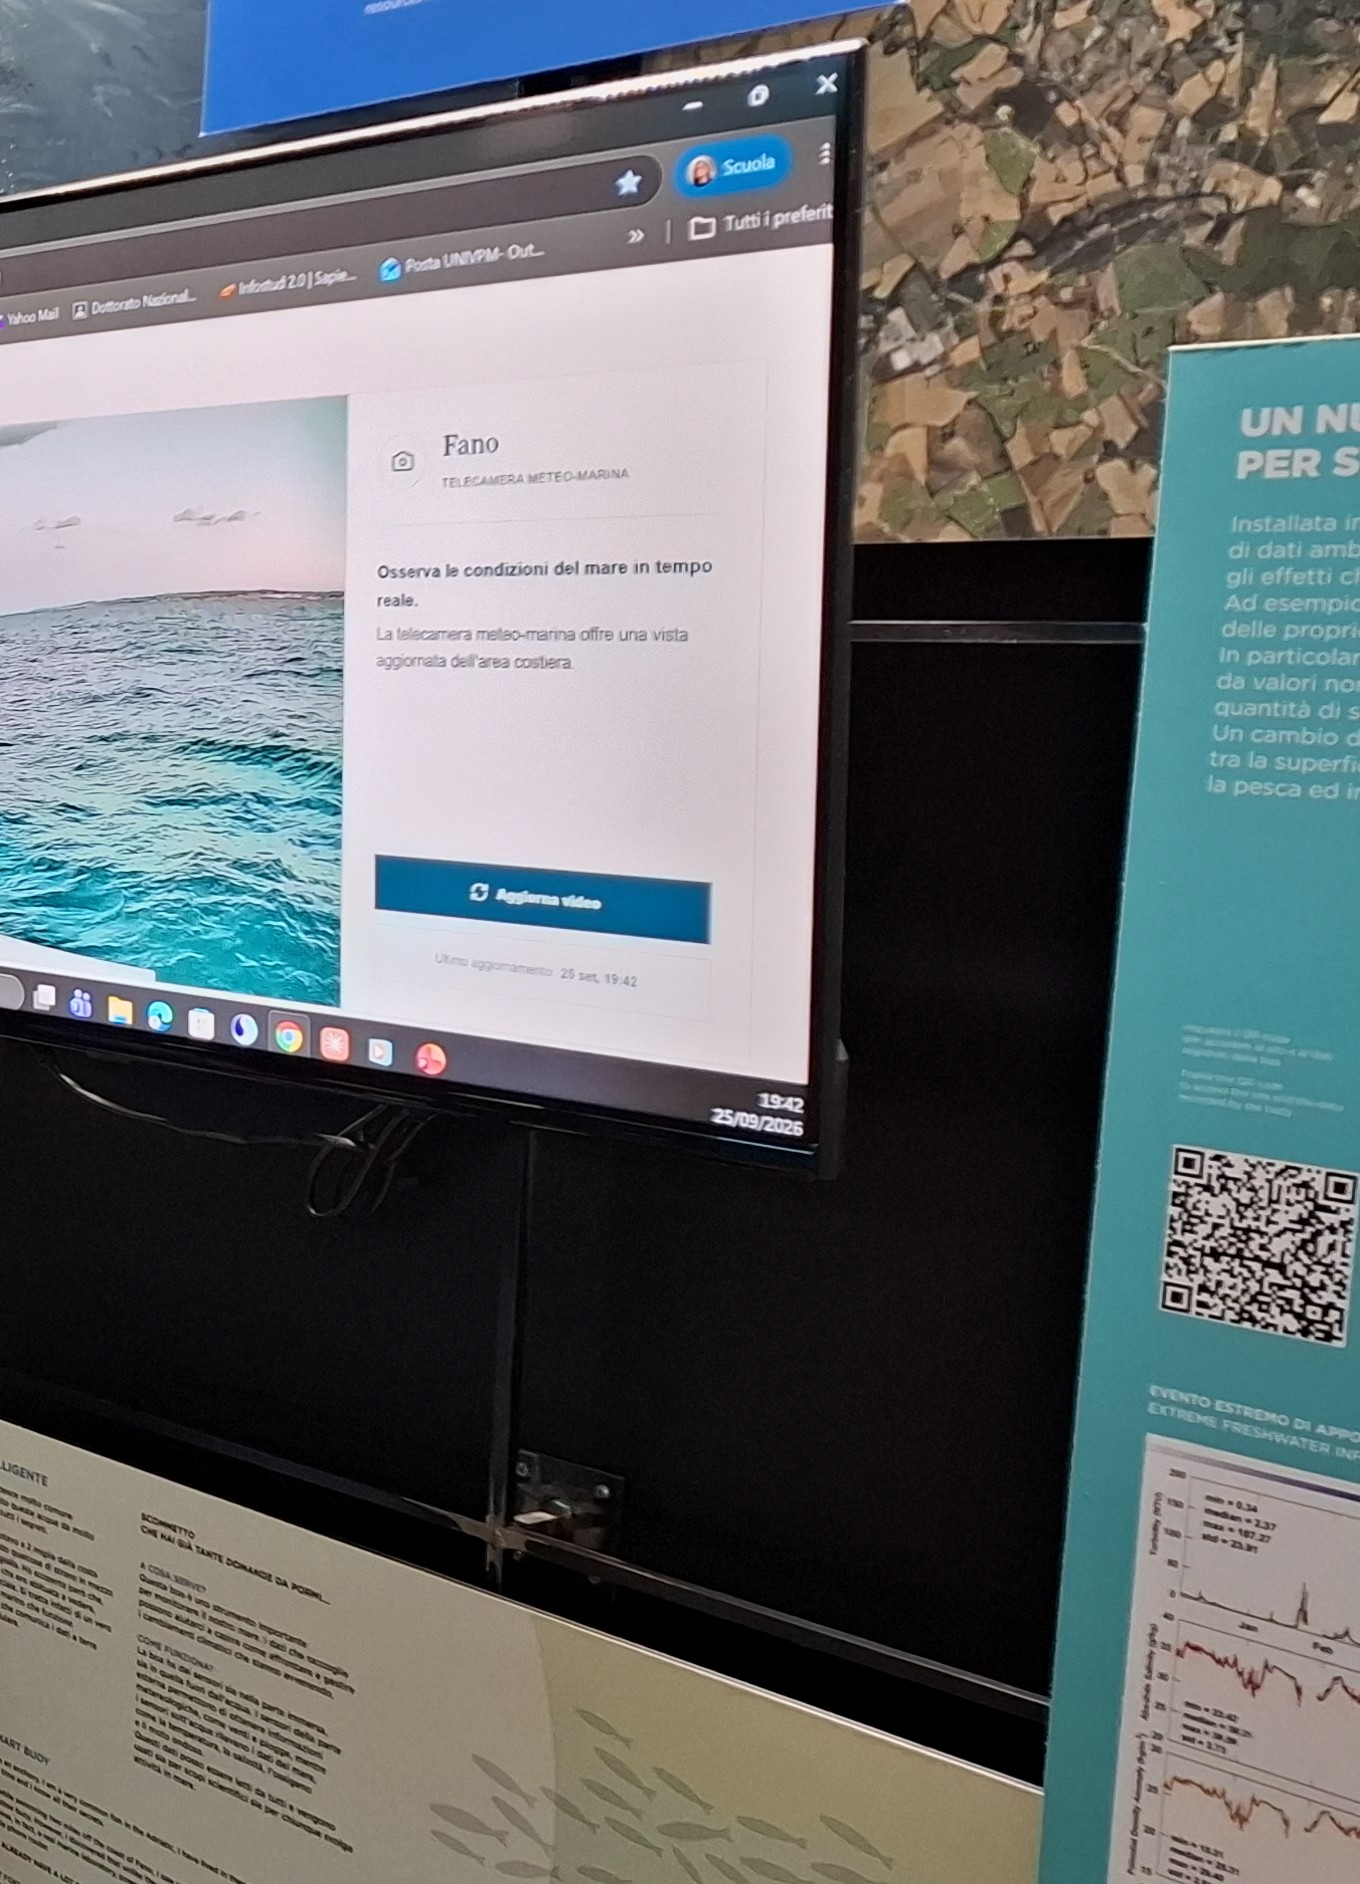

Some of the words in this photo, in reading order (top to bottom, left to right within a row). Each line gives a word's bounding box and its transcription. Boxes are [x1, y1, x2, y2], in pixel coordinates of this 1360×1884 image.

[722, 153, 776, 176] Scuola
[722, 210, 761, 233] Tutti
[405, 258, 441, 272] Posta
[7, 312, 36, 326] Yahoo
[38, 307, 59, 321] Mail
[92, 299, 141, 315] Dottorato
[1241, 406, 1303, 437] UN
[443, 434, 499, 457] Fano
[1237, 449, 1320, 479] PER
[442, 474, 523, 488] TELECAMERA
[527, 468, 628, 484] METEO-MARINA
[1232, 515, 1337, 533] Installata
[1228, 542, 1250, 560] di
[1257, 541, 1303, 559] dati
[377, 565, 441, 580] Osserva
[446, 564, 459, 578] le
[463, 563, 548, 578] condizioni
[554, 562, 579, 576] del
[585, 563, 627, 575] mare
[635, 562, 649, 574] in
[656, 560, 712, 577] tempo
[1226, 567, 1253, 588] gli
[1261, 567, 1332, 586] effetti
[377, 594, 419, 608] reale.
[1224, 594, 1256, 612] Ad
[376, 627, 392, 642] La
[397, 627, 472, 642] telecamera
[476, 627, 576, 642] meteo-marina
[580, 627, 614, 641] offre
[619, 629, 647, 642] una
[653, 627, 688, 642] vista
[1221, 620, 1276, 639] delle
[376, 654, 446, 670] aggiornata
[1219, 647, 1240, 664] In
[1216, 673, 1244, 691] da
[1253, 673, 1317, 693] valori
[1214, 698, 1312, 721] quantità
[1318, 700, 1341, 719] di
[1212, 724, 1243, 743] Un
[1250, 726, 1338, 746] cambio
[1209, 751, 1241, 769] tra
[1247, 751, 1268, 770] la
[1207, 776, 1227, 794] la
[1233, 779, 1302, 800] pesca
[1309, 781, 1340, 799] ed
[496, 888, 559, 906] Aggiorna
[561, 894, 602, 910] video
[435, 953, 468, 967] Ultimo
[560, 968, 575, 979] 25
[604, 973, 638, 987] 19:42
[757, 1092, 804, 1113] 19:42
[710, 1108, 804, 1136] 25/09/2026
[1150, 1385, 1211, 1408] EVENTO
[1215, 1400, 1290, 1426] ESTREMO
[1293, 1418, 1312, 1432] DI
[1148, 1402, 1217, 1428] EXTREME
[1222, 1420, 1330, 1453] FRESHWATER
